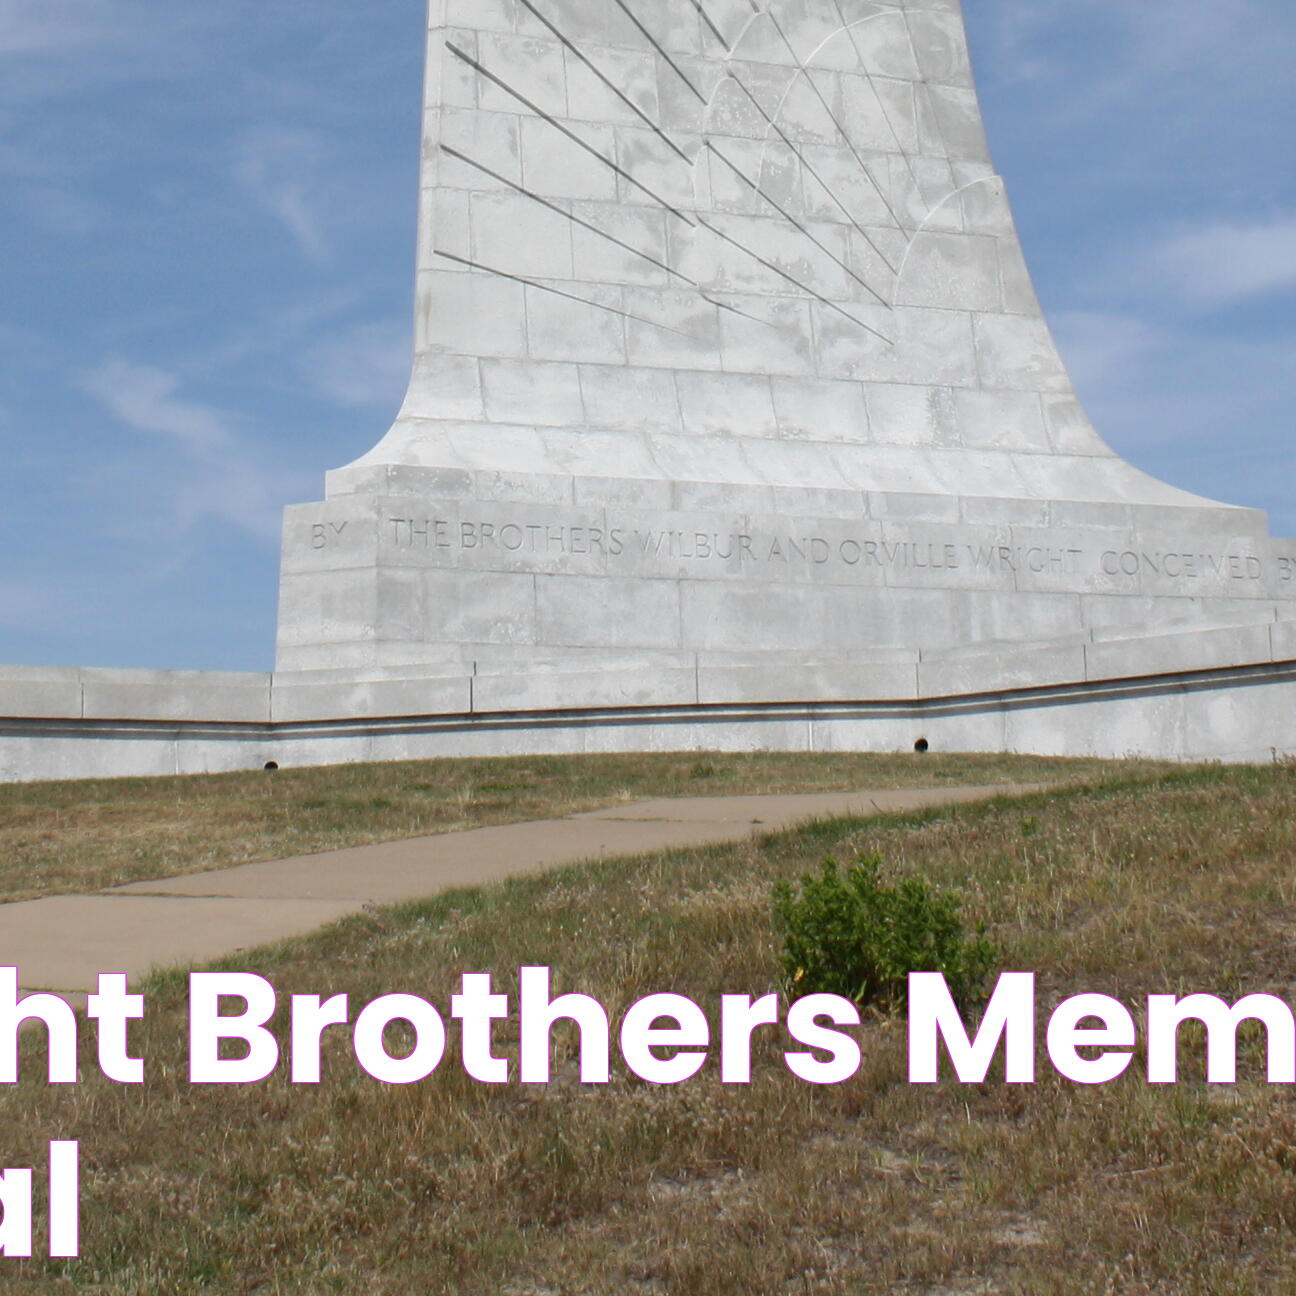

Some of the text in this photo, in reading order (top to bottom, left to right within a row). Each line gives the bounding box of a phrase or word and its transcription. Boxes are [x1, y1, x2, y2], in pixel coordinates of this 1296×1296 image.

[310, 520, 349, 551] BY
[388, 517, 451, 548] THE
[460, 520, 625, 557] BROTHERS
[633, 529, 758, 562] WILBUR
[767, 535, 831, 565] AND
[839, 538, 960, 569] ORVILLE
[966, 543, 1084, 573] WRIGHT
[1100, 549, 1262, 580] CONCEIVED
